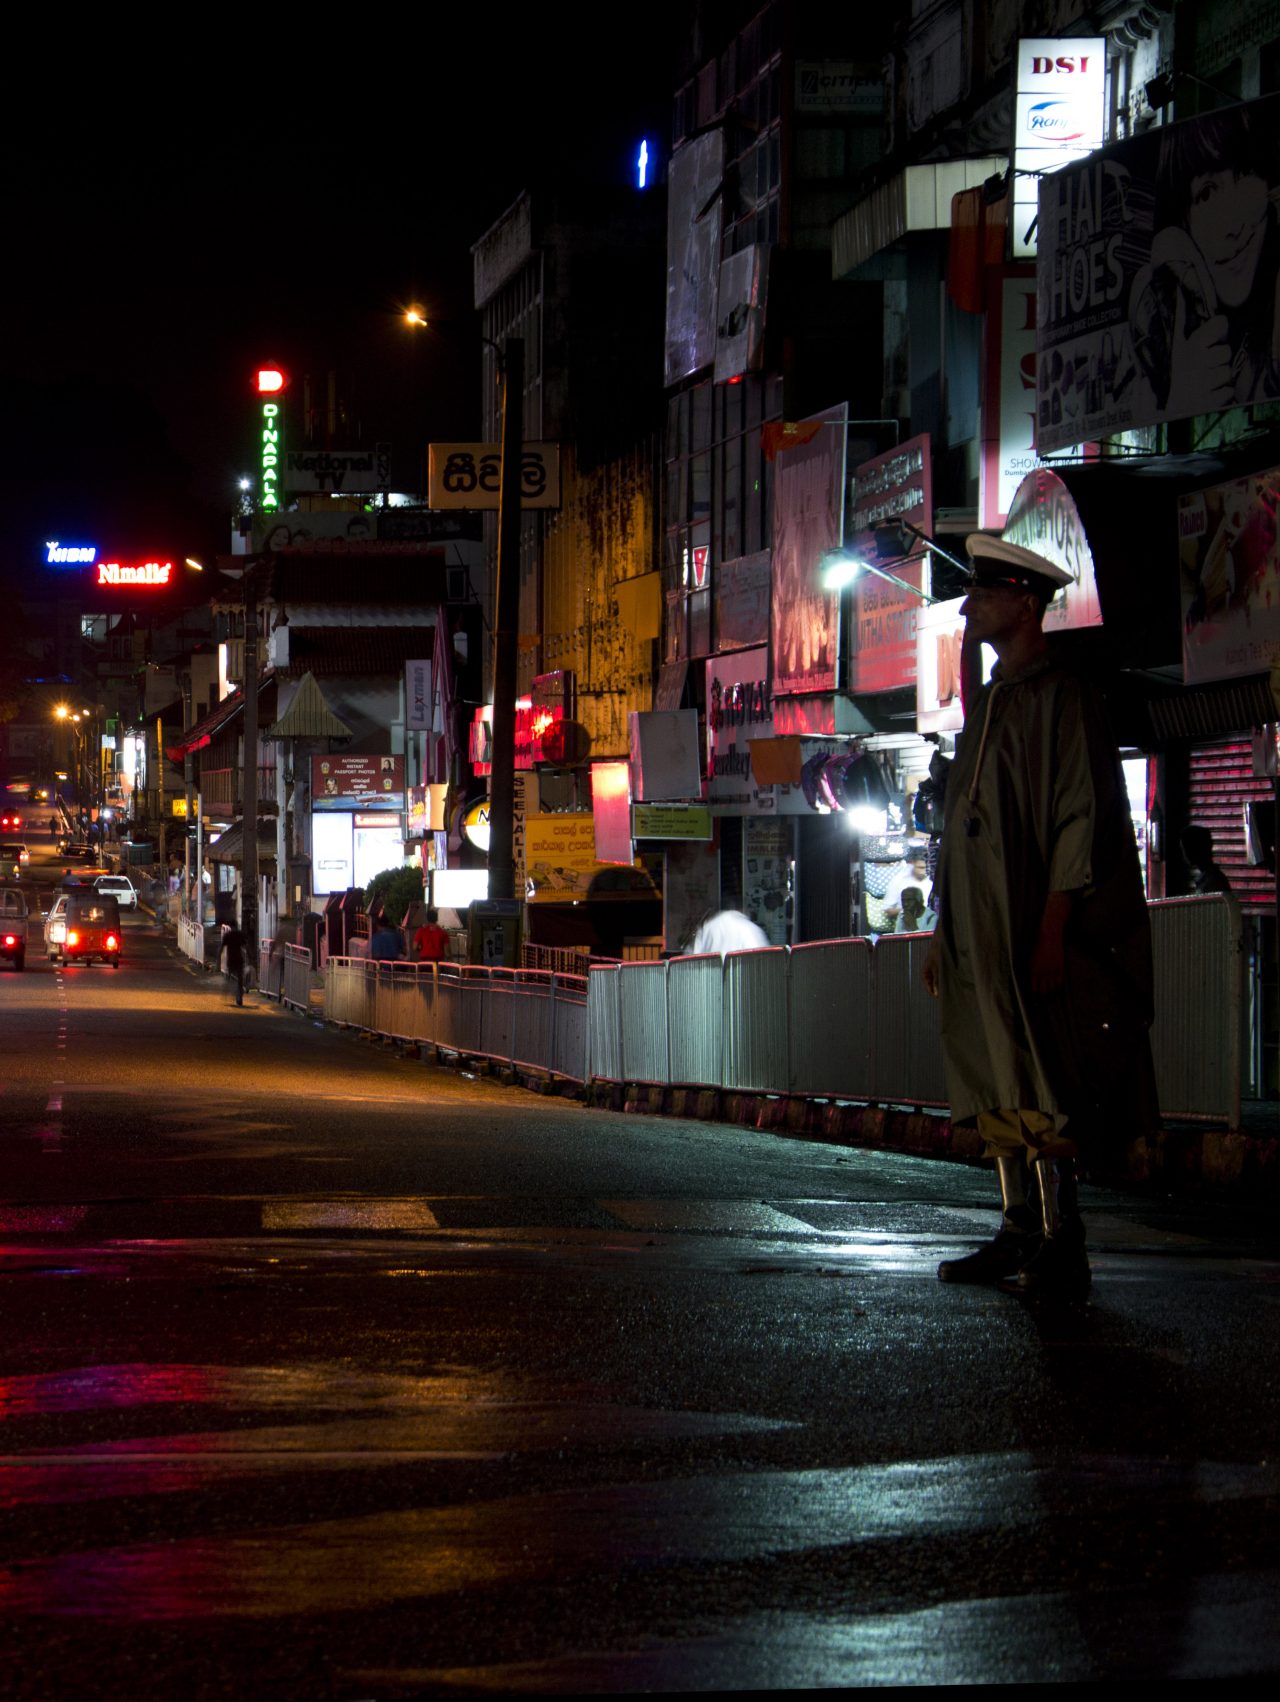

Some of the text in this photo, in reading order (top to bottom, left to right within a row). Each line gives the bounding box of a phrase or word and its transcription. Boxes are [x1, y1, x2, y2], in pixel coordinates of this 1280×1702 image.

[1032, 56, 1090, 75] DSI
[262, 403, 279, 507] DINAPALA
[287, 453, 374, 473] National
[315, 472, 346, 489] TV
